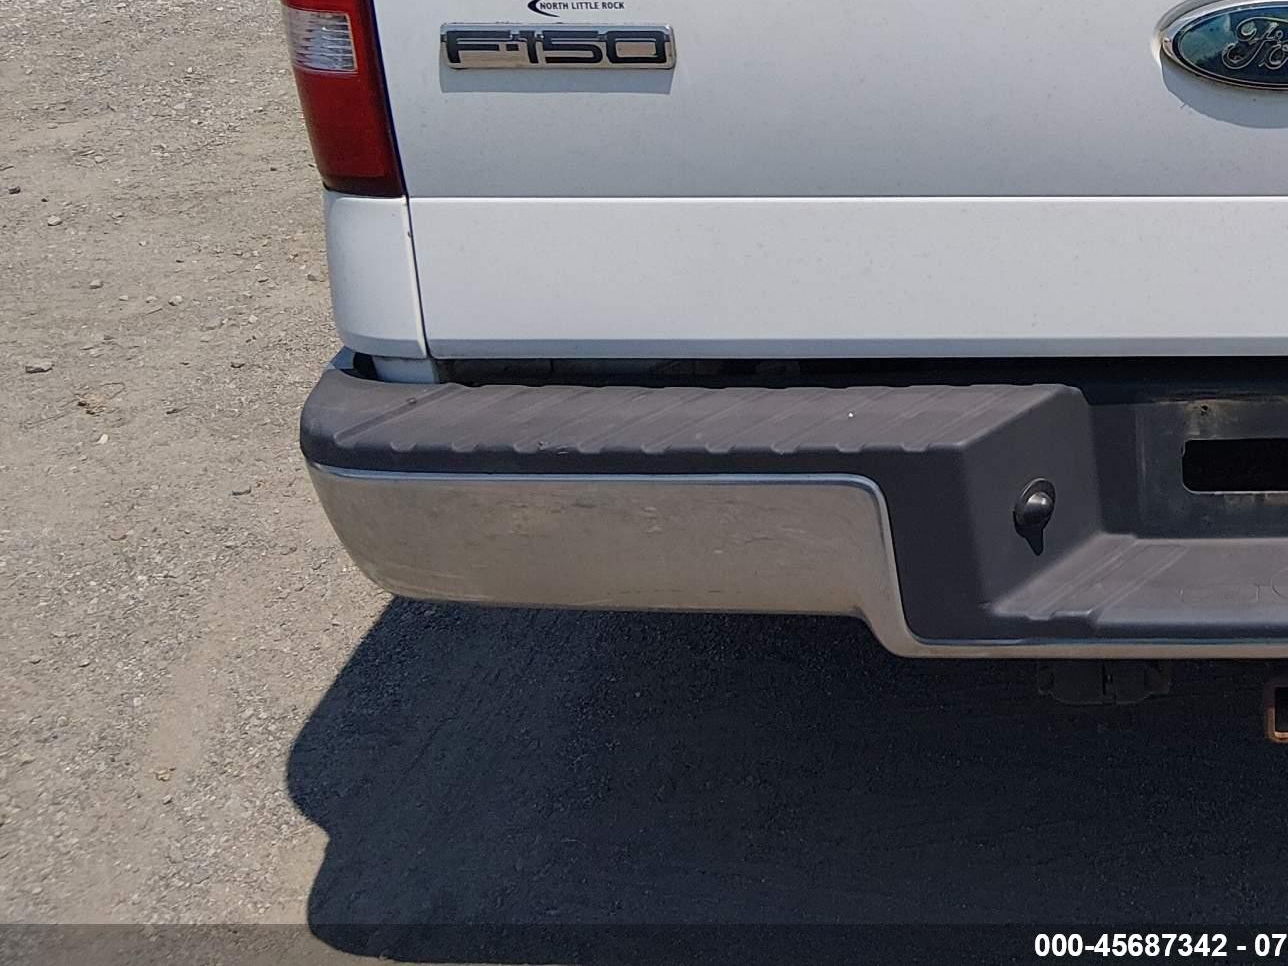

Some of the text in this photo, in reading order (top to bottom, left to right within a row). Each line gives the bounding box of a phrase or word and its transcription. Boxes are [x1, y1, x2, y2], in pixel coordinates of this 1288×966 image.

[539, 1, 625, 11] NORTH LITTLE ROCK
[445, 30, 668, 64] F-150
